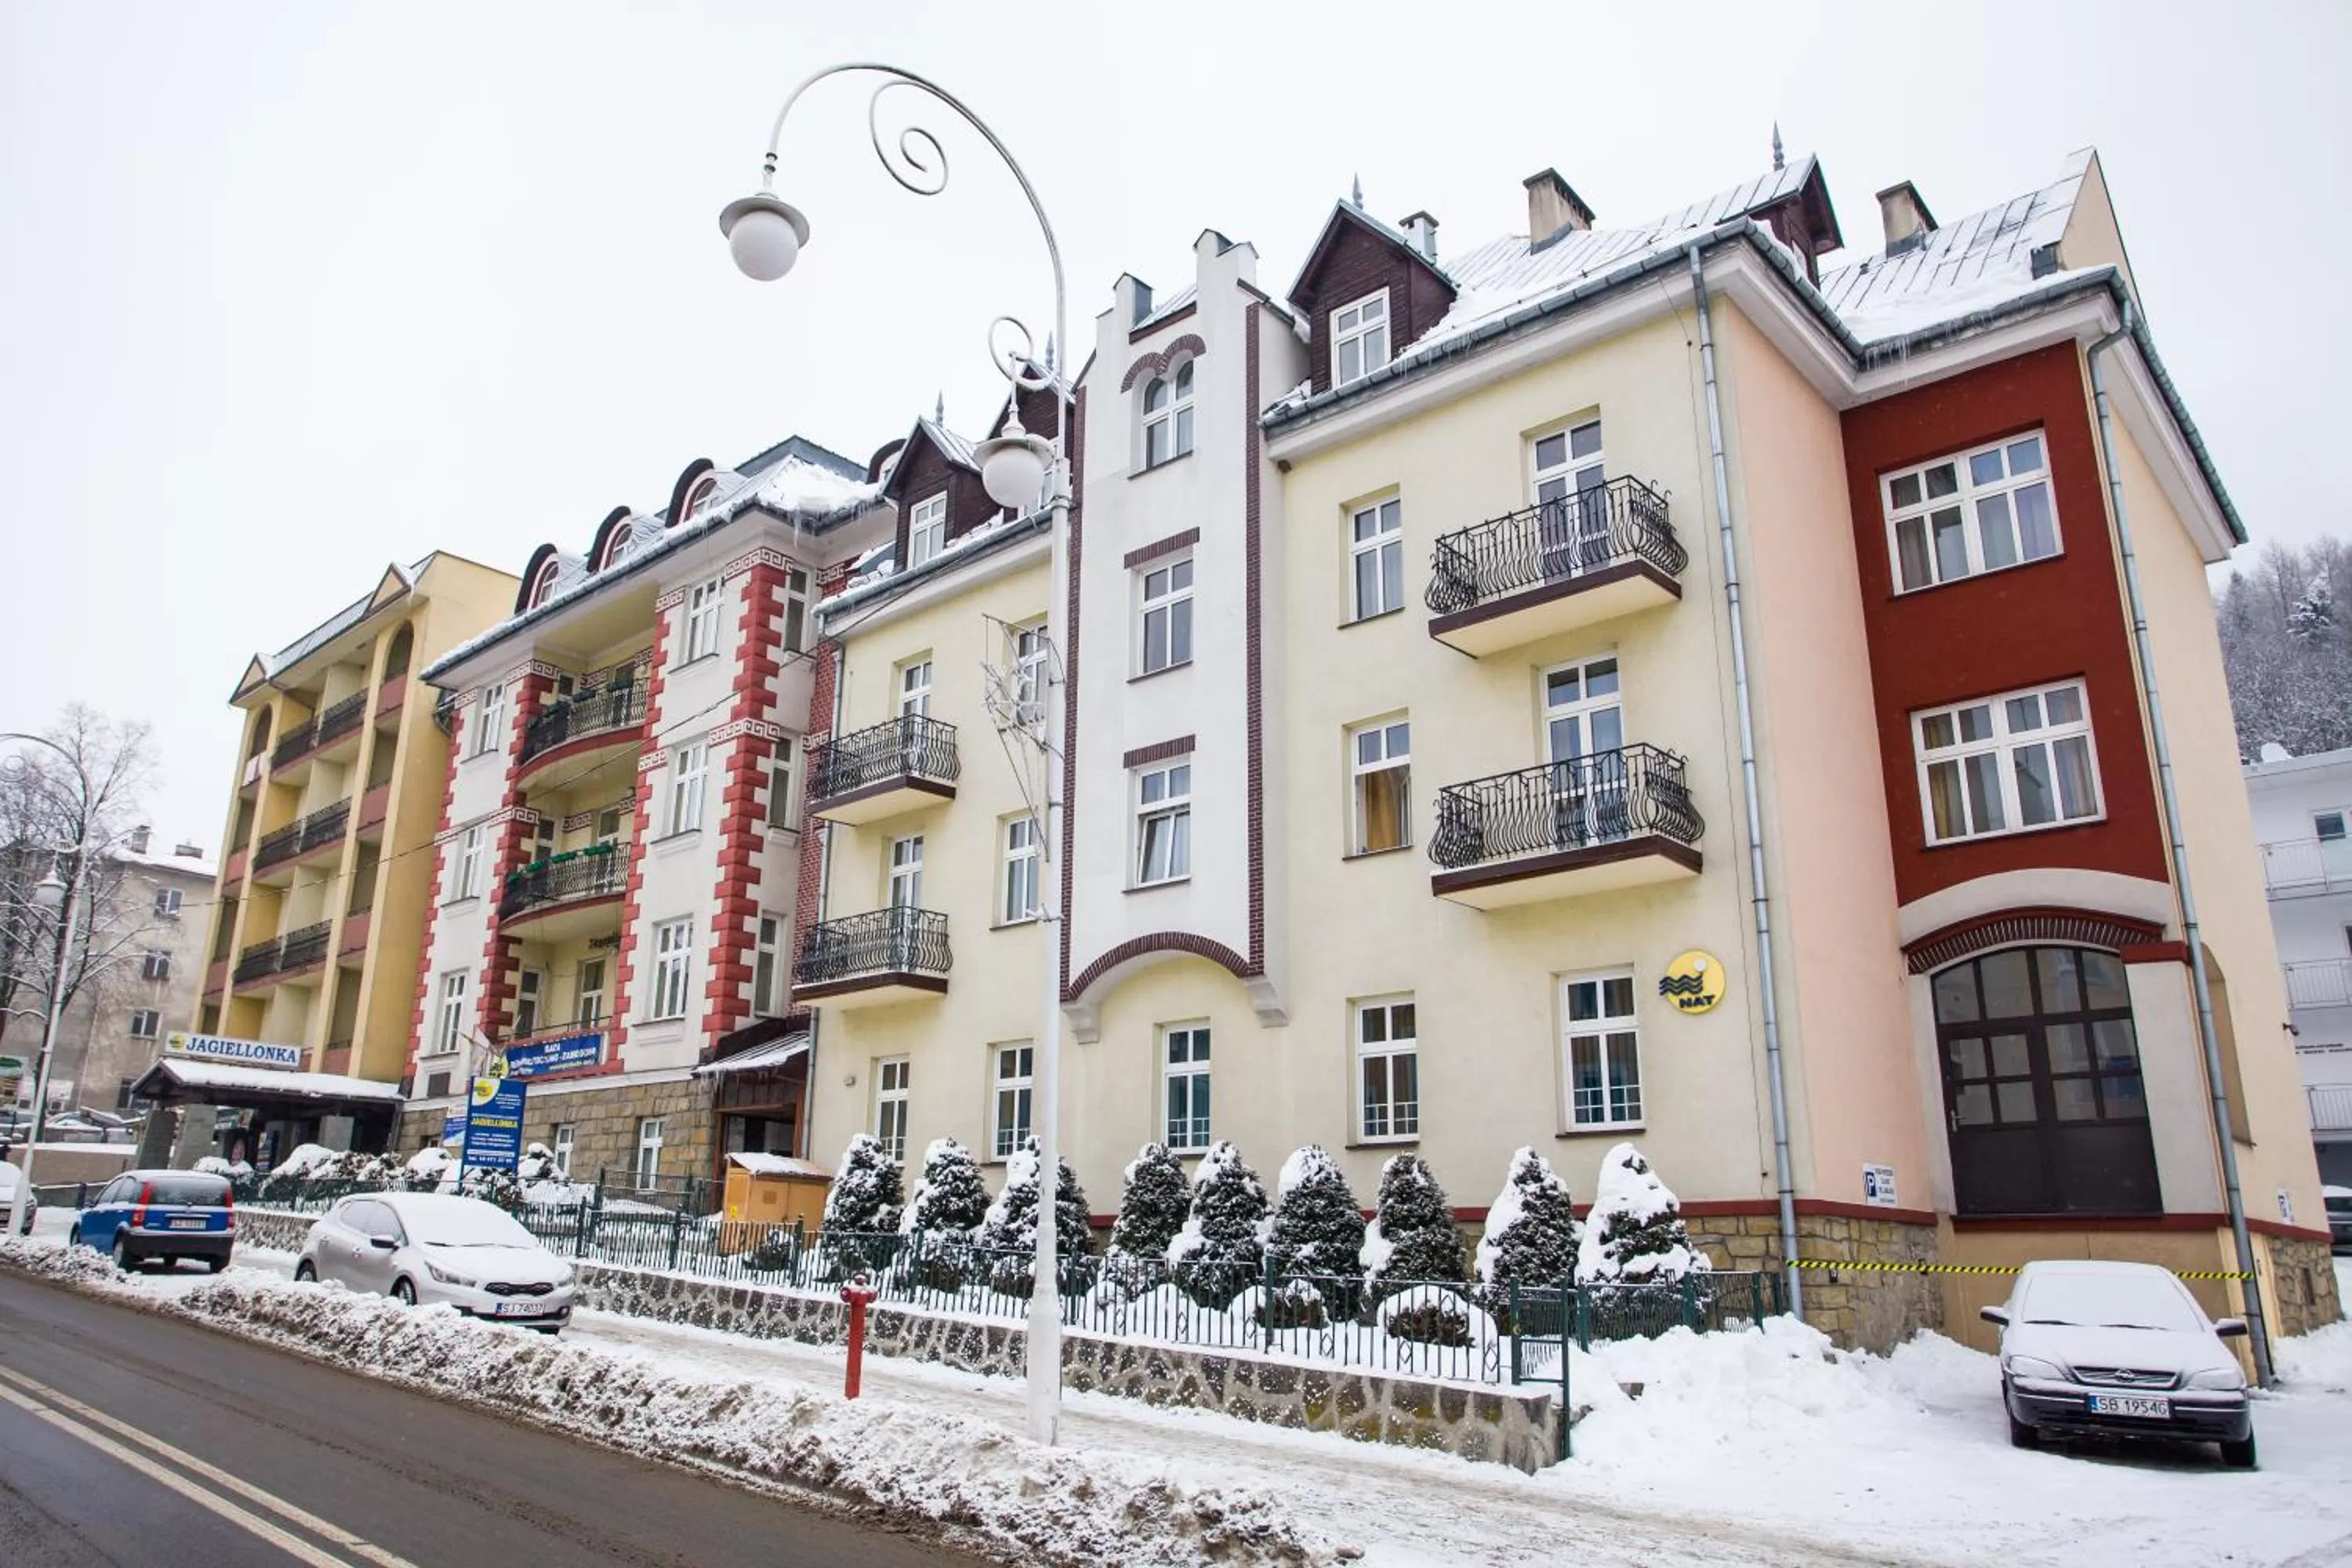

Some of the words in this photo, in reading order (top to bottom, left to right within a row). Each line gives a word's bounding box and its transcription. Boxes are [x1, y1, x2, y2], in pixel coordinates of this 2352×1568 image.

[1679, 994, 1715, 1007] NAT
[187, 1037, 296, 1063] JAGIELLONKA
[470, 1119, 517, 1129] JAGIELLONKA
[2099, 1398, 2119, 1411] SB
